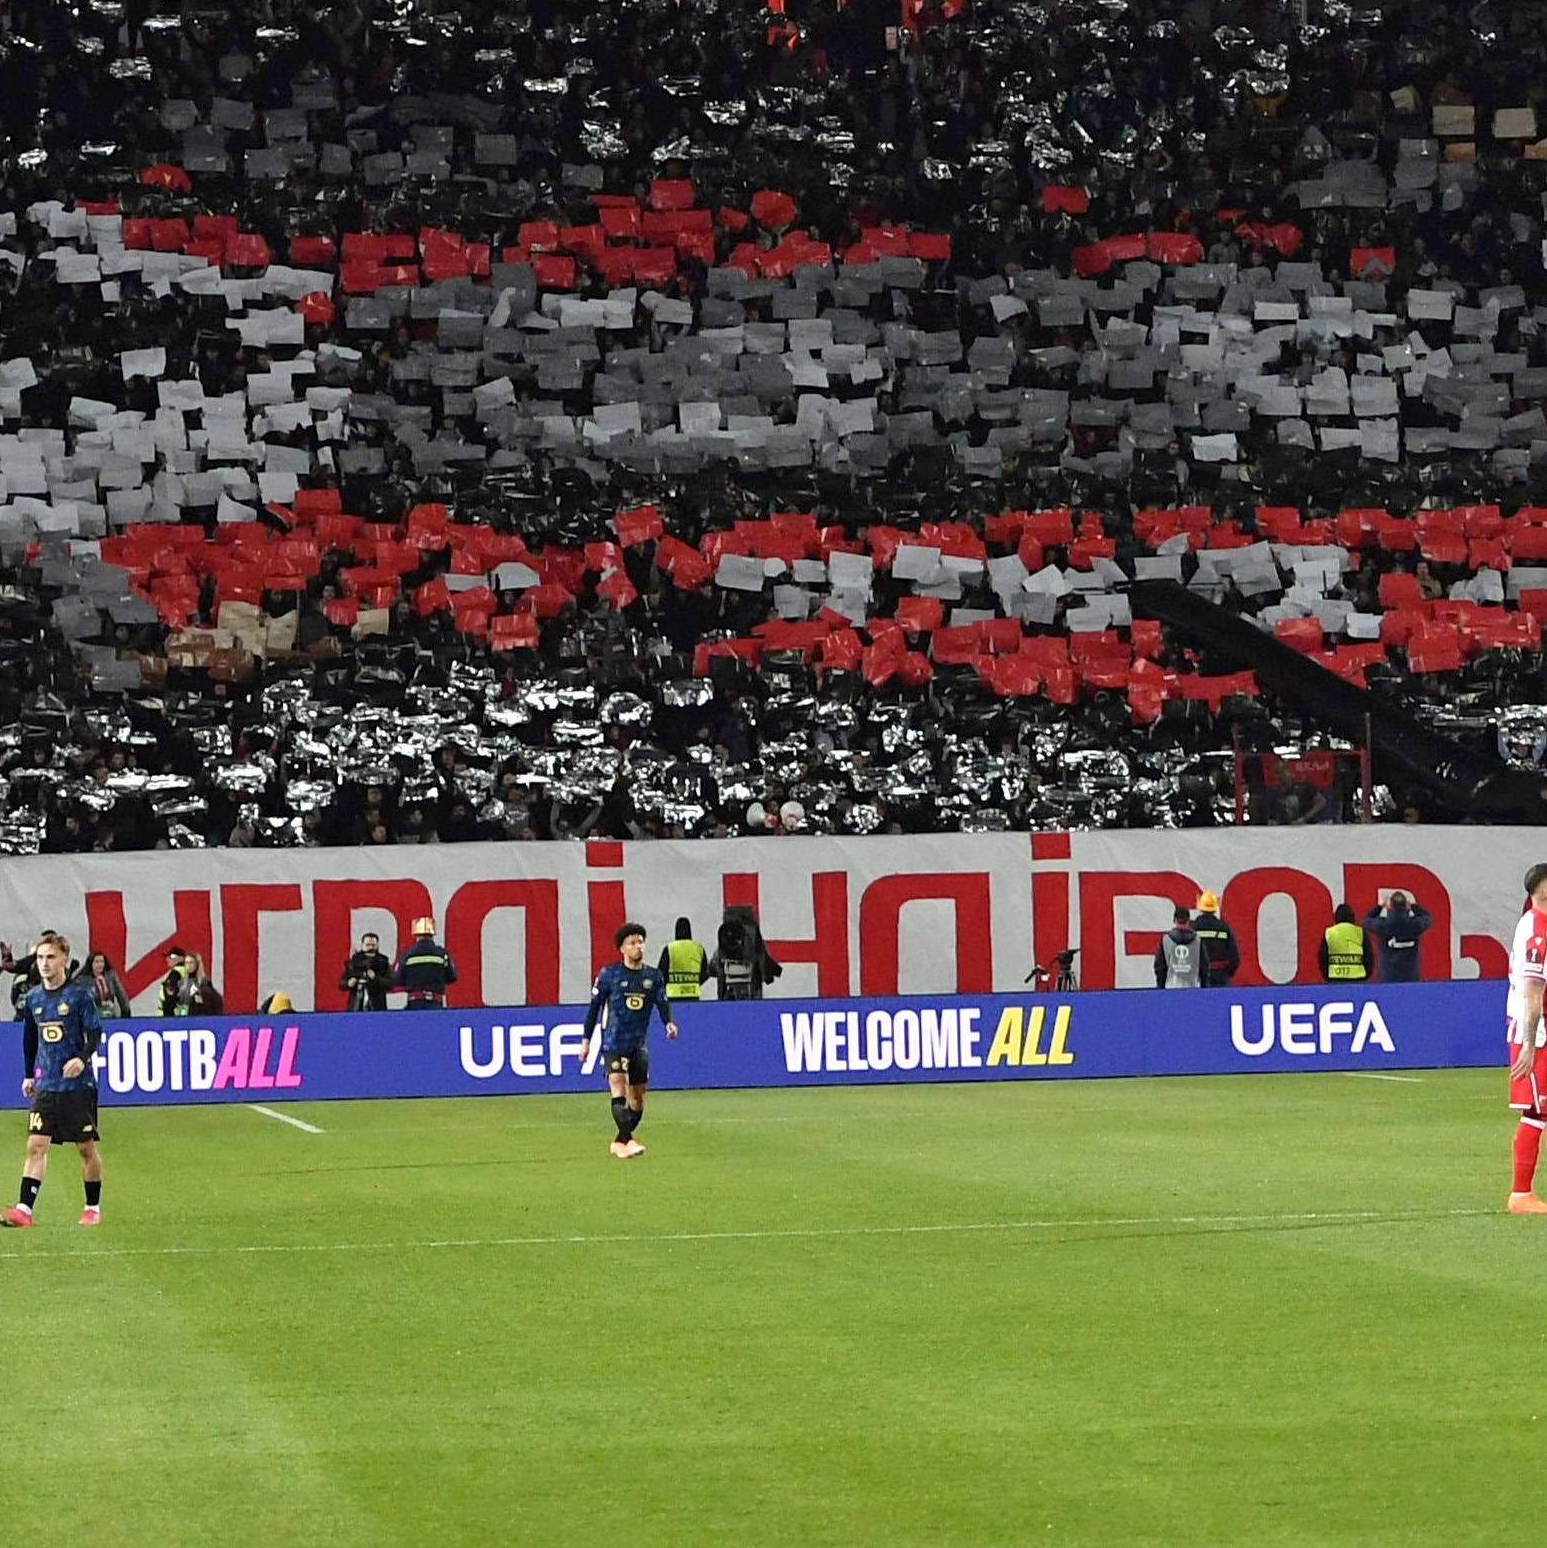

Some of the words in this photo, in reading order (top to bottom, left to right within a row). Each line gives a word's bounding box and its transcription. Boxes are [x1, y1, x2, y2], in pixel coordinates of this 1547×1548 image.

[780, 1007, 983, 1073] WELCOME
[986, 1005, 1074, 1067] ALL
[1230, 1001, 1396, 1056] UEFA
[28, 1112, 44, 1131] 14
